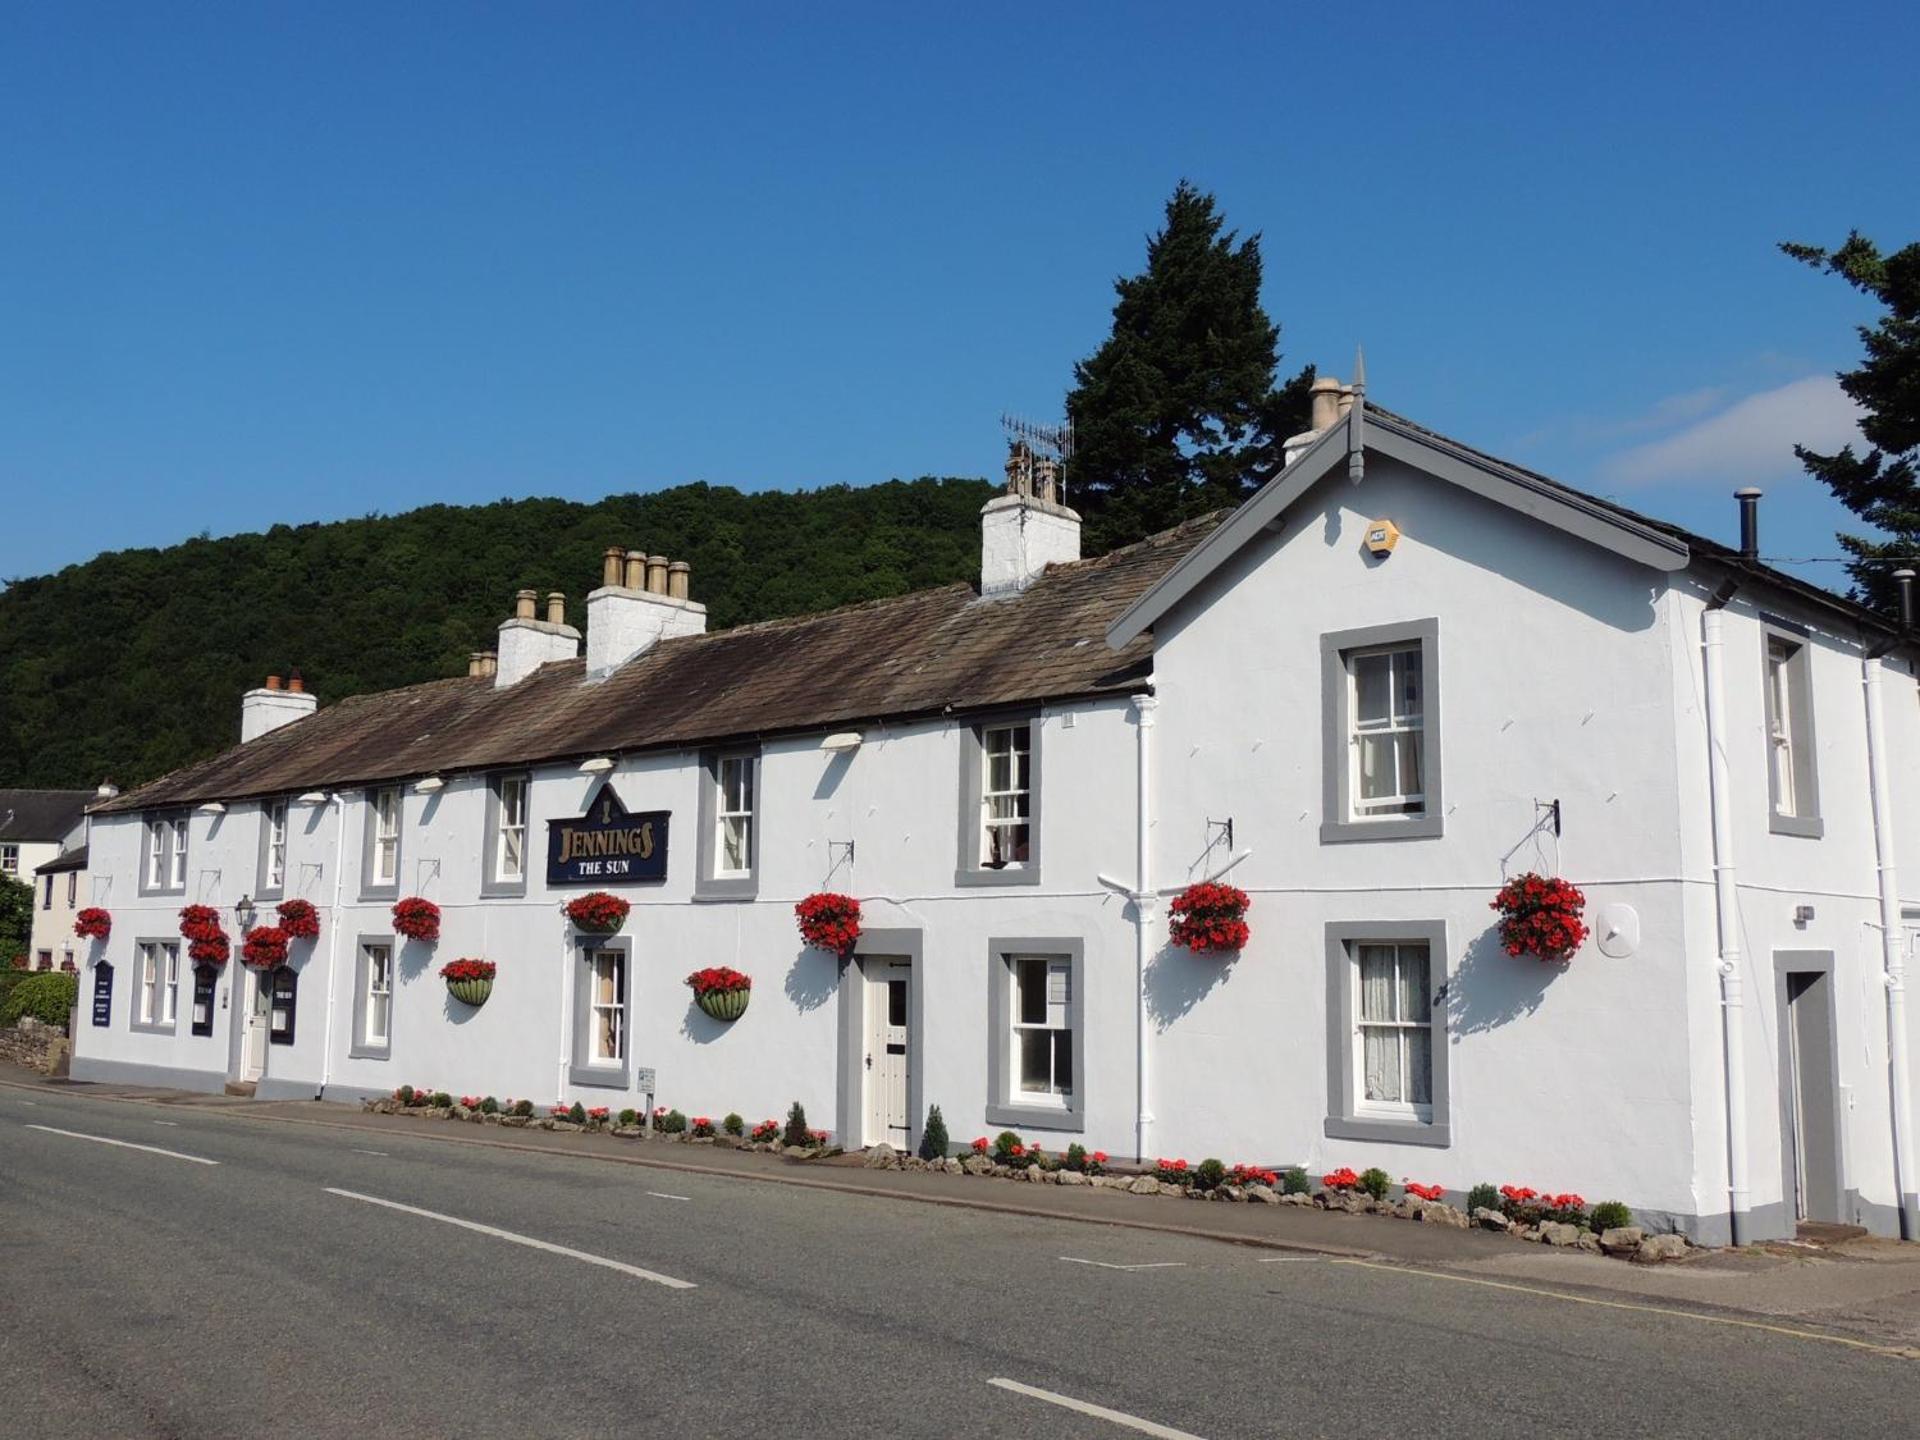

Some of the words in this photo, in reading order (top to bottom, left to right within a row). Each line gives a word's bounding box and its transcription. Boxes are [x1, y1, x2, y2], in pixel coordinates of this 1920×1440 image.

[559, 823, 654, 863] JENNINGS
[579, 862, 602, 875] THE
[606, 860, 630, 873] SUN
